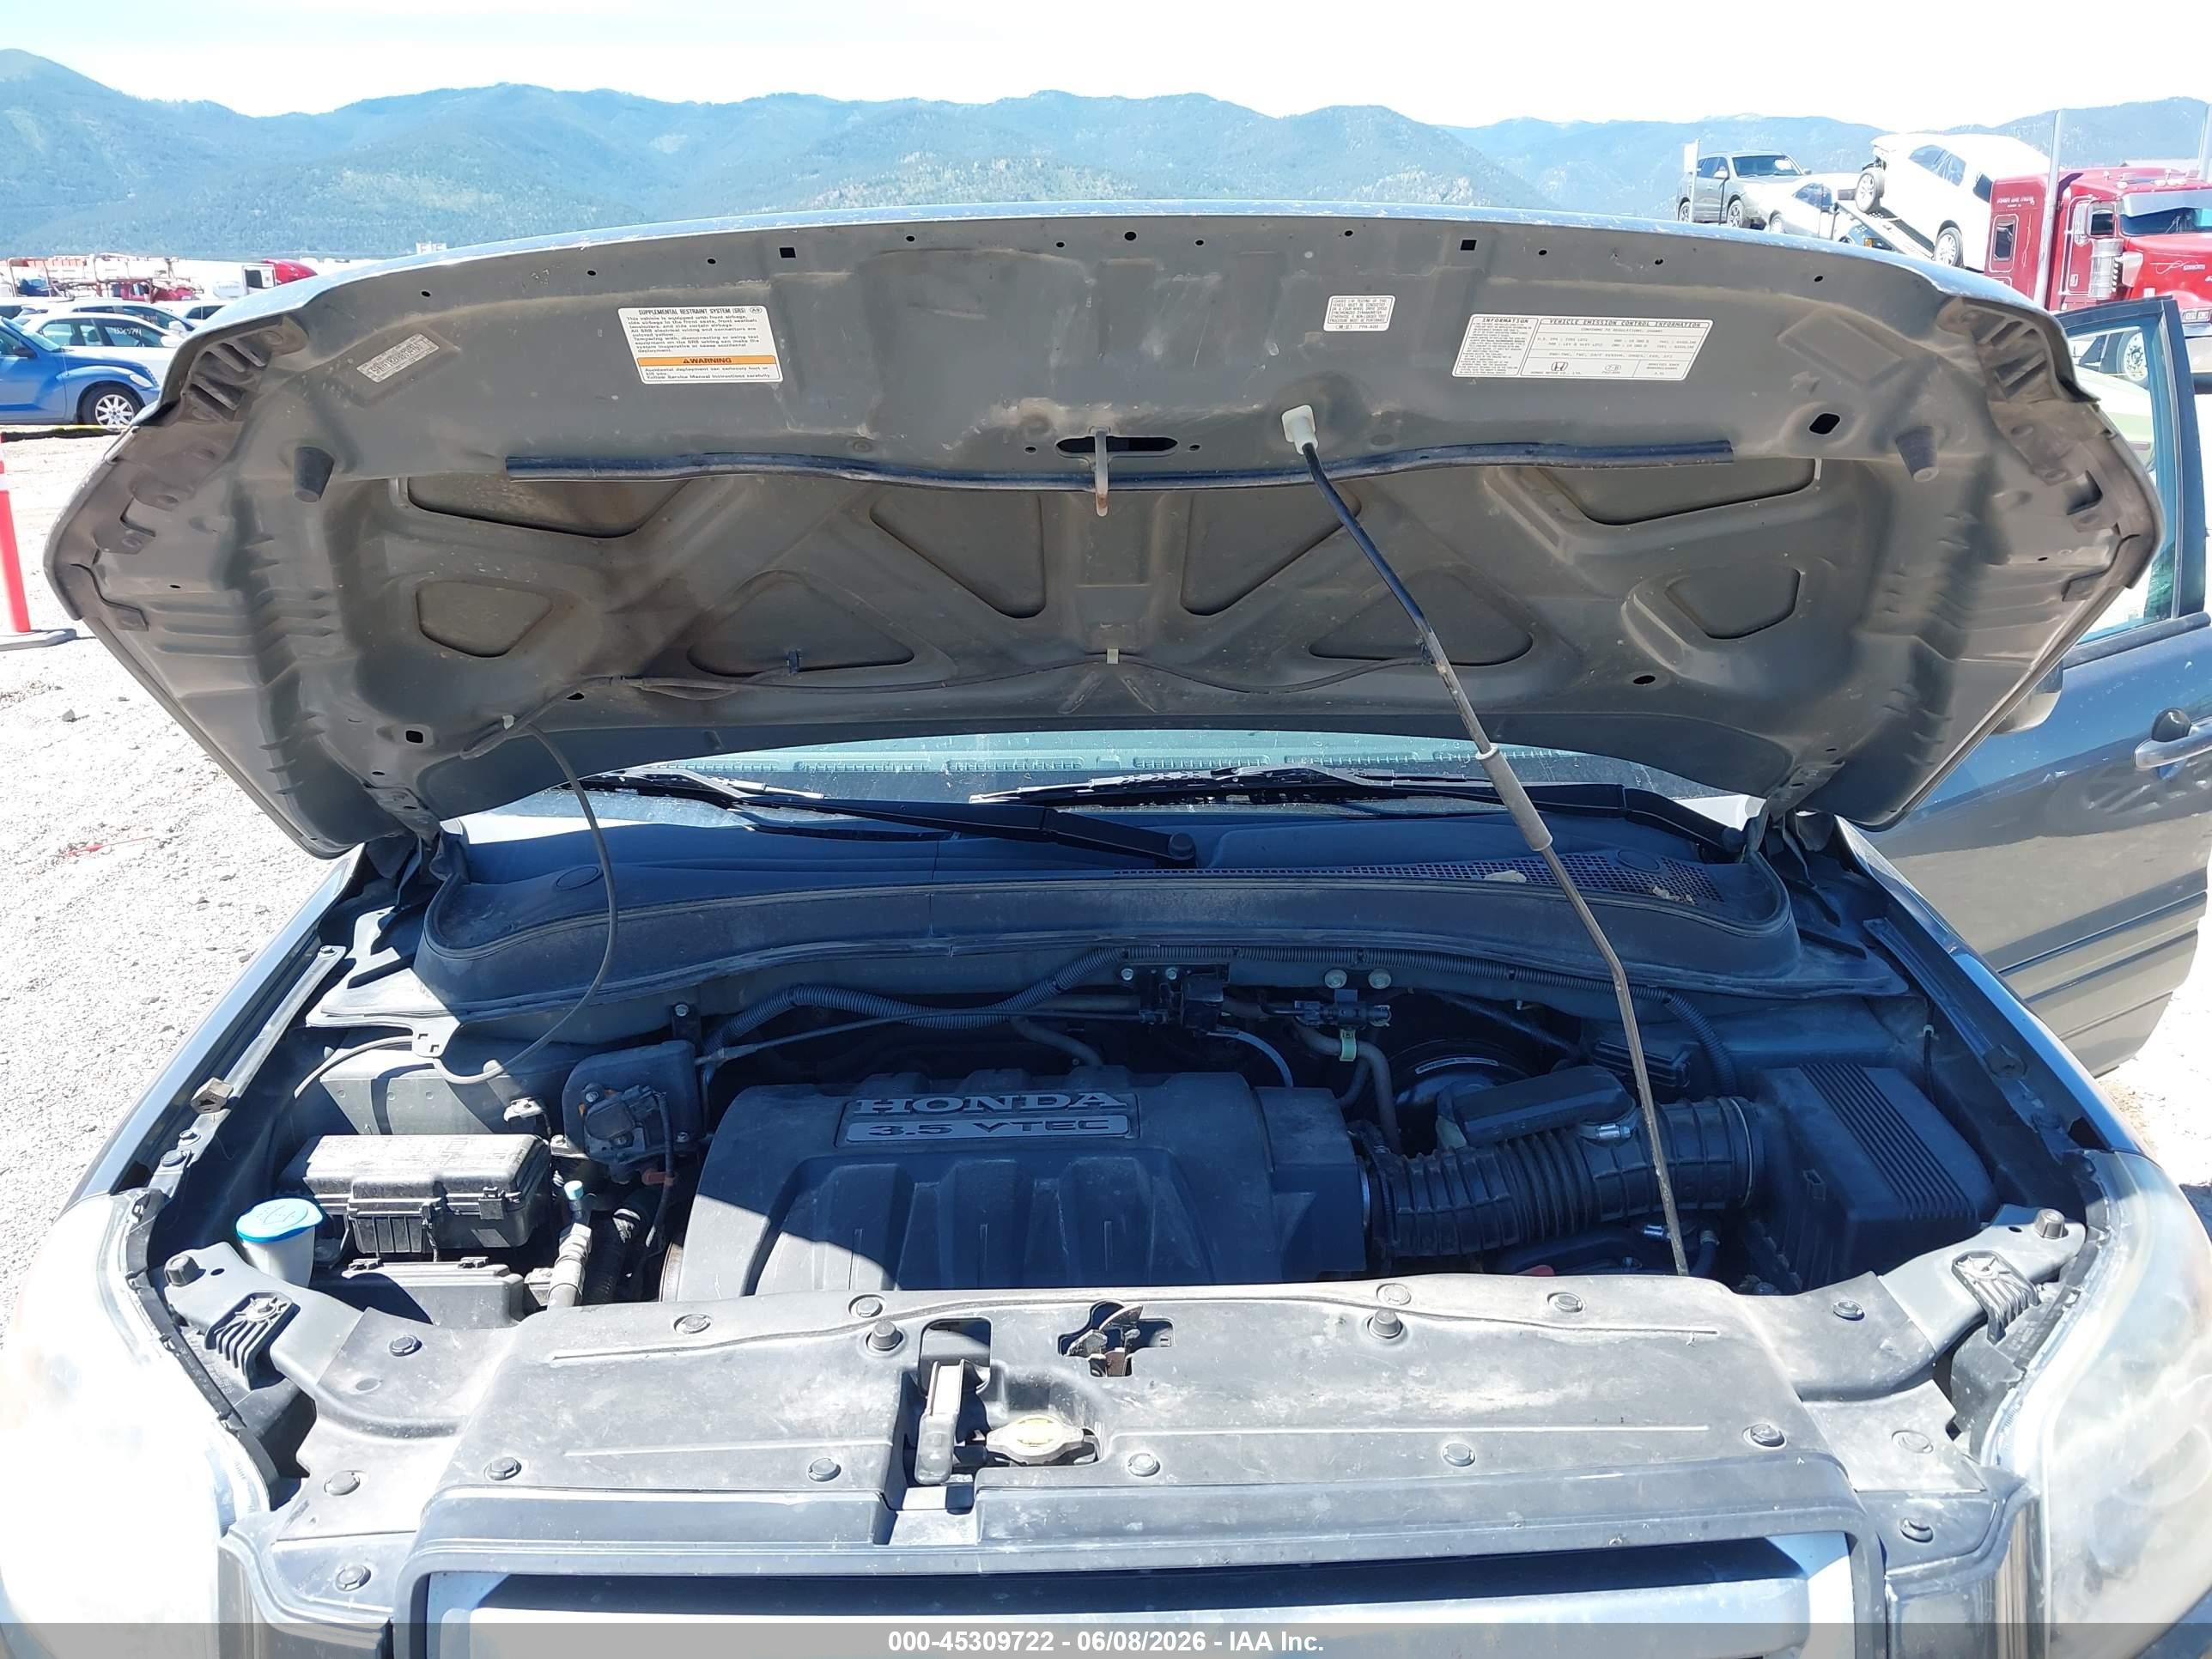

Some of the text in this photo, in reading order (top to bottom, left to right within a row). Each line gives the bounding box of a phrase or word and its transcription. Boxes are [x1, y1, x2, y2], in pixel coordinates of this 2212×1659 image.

[854, 1092, 1127, 1115] HONDA
[868, 1119, 1109, 1137] 3.5 VTEC
